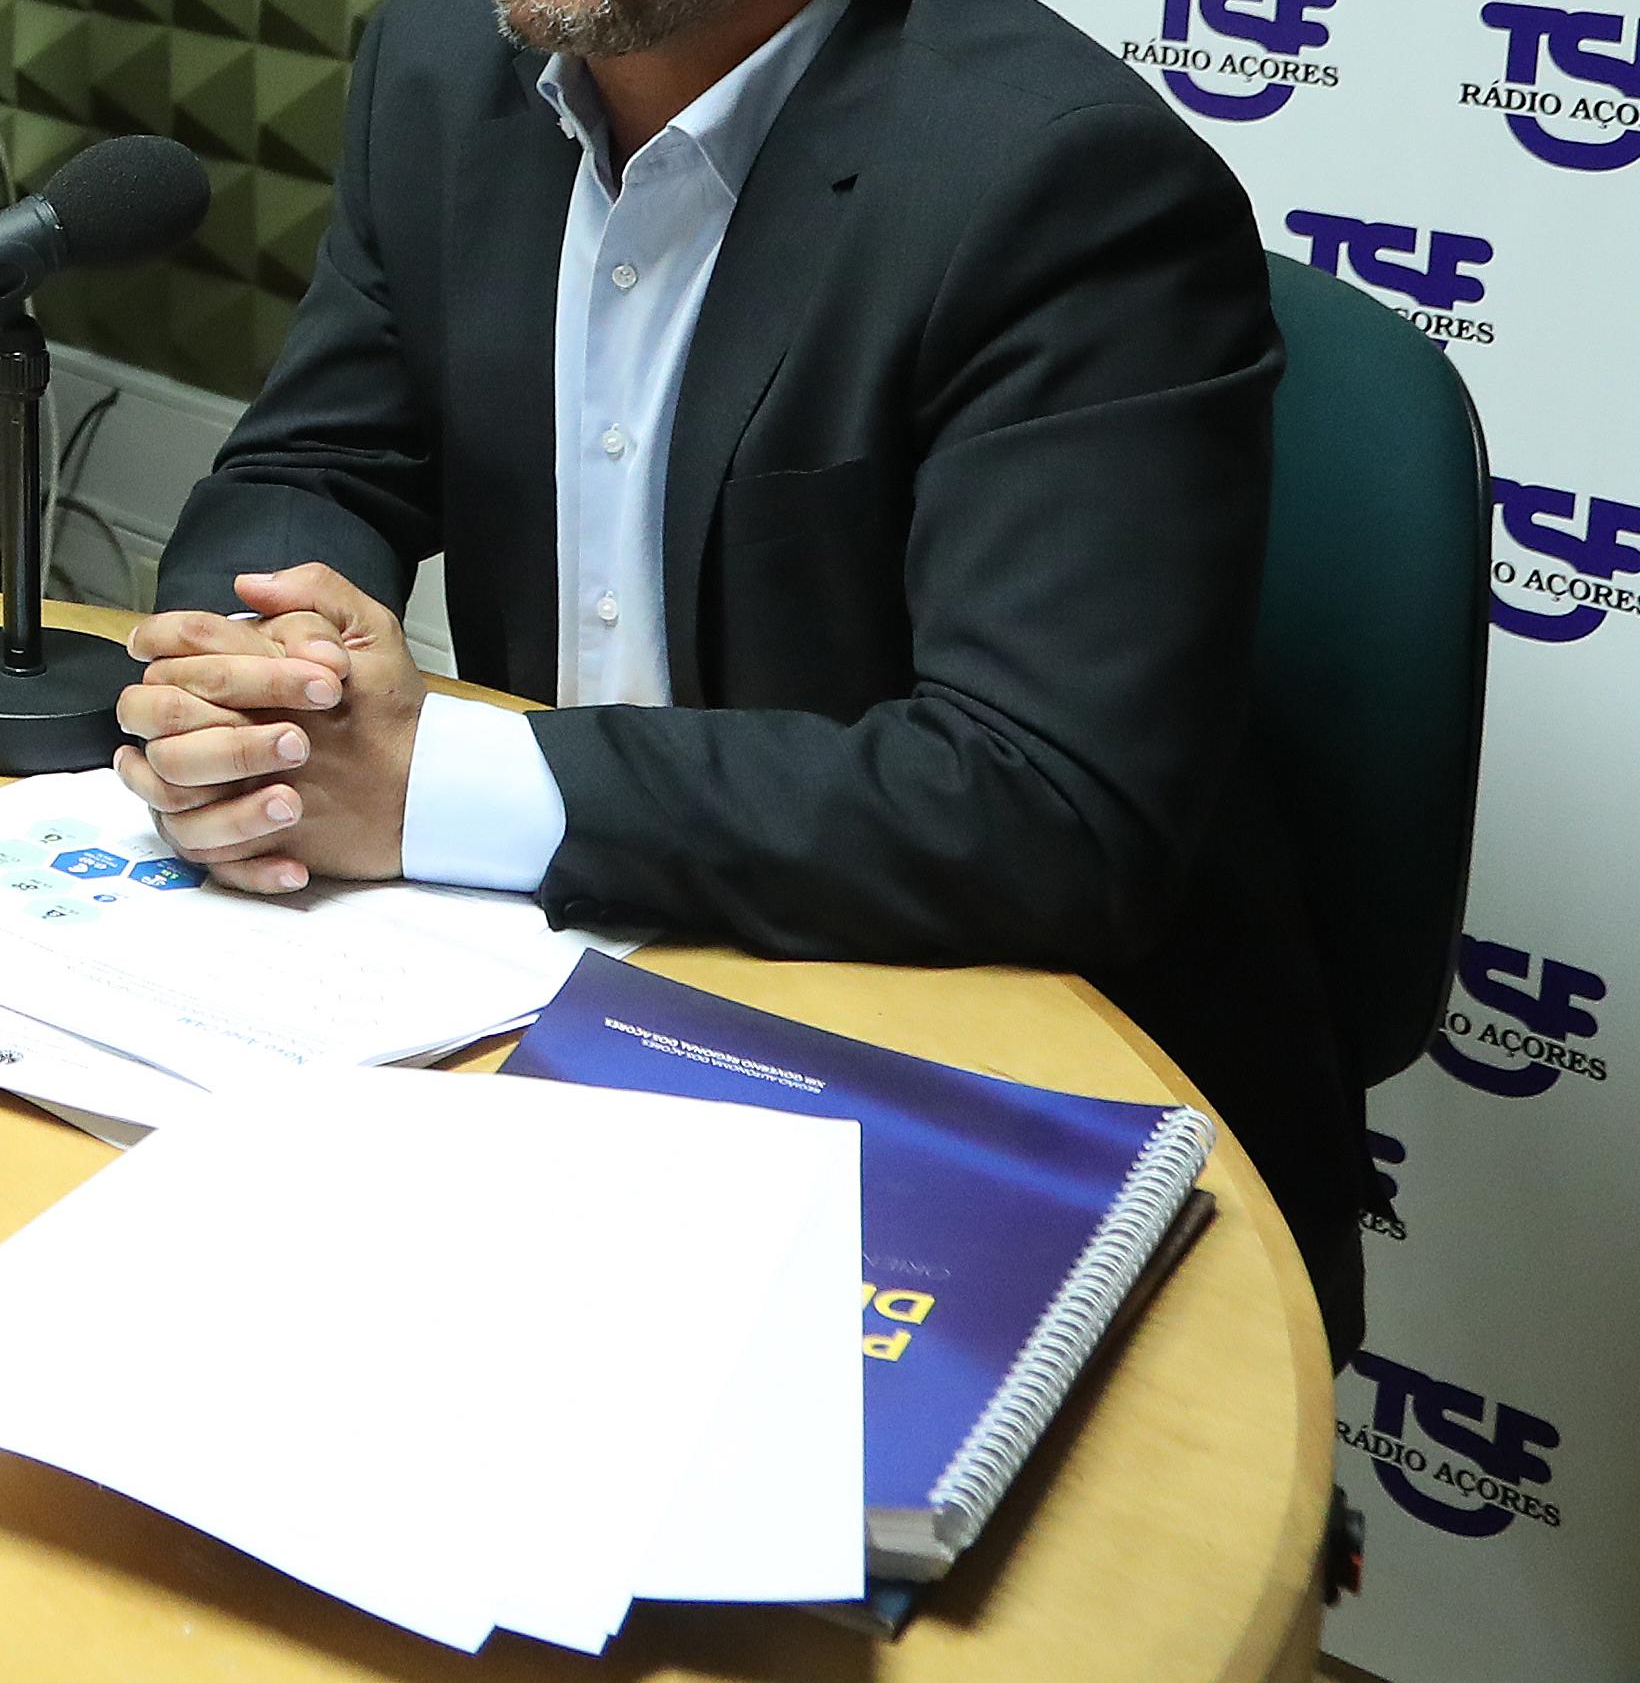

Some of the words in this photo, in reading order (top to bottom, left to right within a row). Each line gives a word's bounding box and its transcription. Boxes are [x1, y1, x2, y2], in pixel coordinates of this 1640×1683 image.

[1120, 36, 1212, 71] RÁDIO
[1217, 53, 1340, 88] AÇORES
[1480, 1, 1640, 100] TS
[1458, 80, 1562, 116] RÁDIO
[1570, 97, 1640, 130] AÇO
[1285, 209, 1494, 311] TSF
[1394, 308, 1495, 344] ORES
[1523, 569, 1640, 615] AÇORE
[1477, 1023, 1607, 1081] AÇORES
[1352, 1348, 1560, 1485] TSF
[1433, 1462, 1561, 1528] AÇORES
